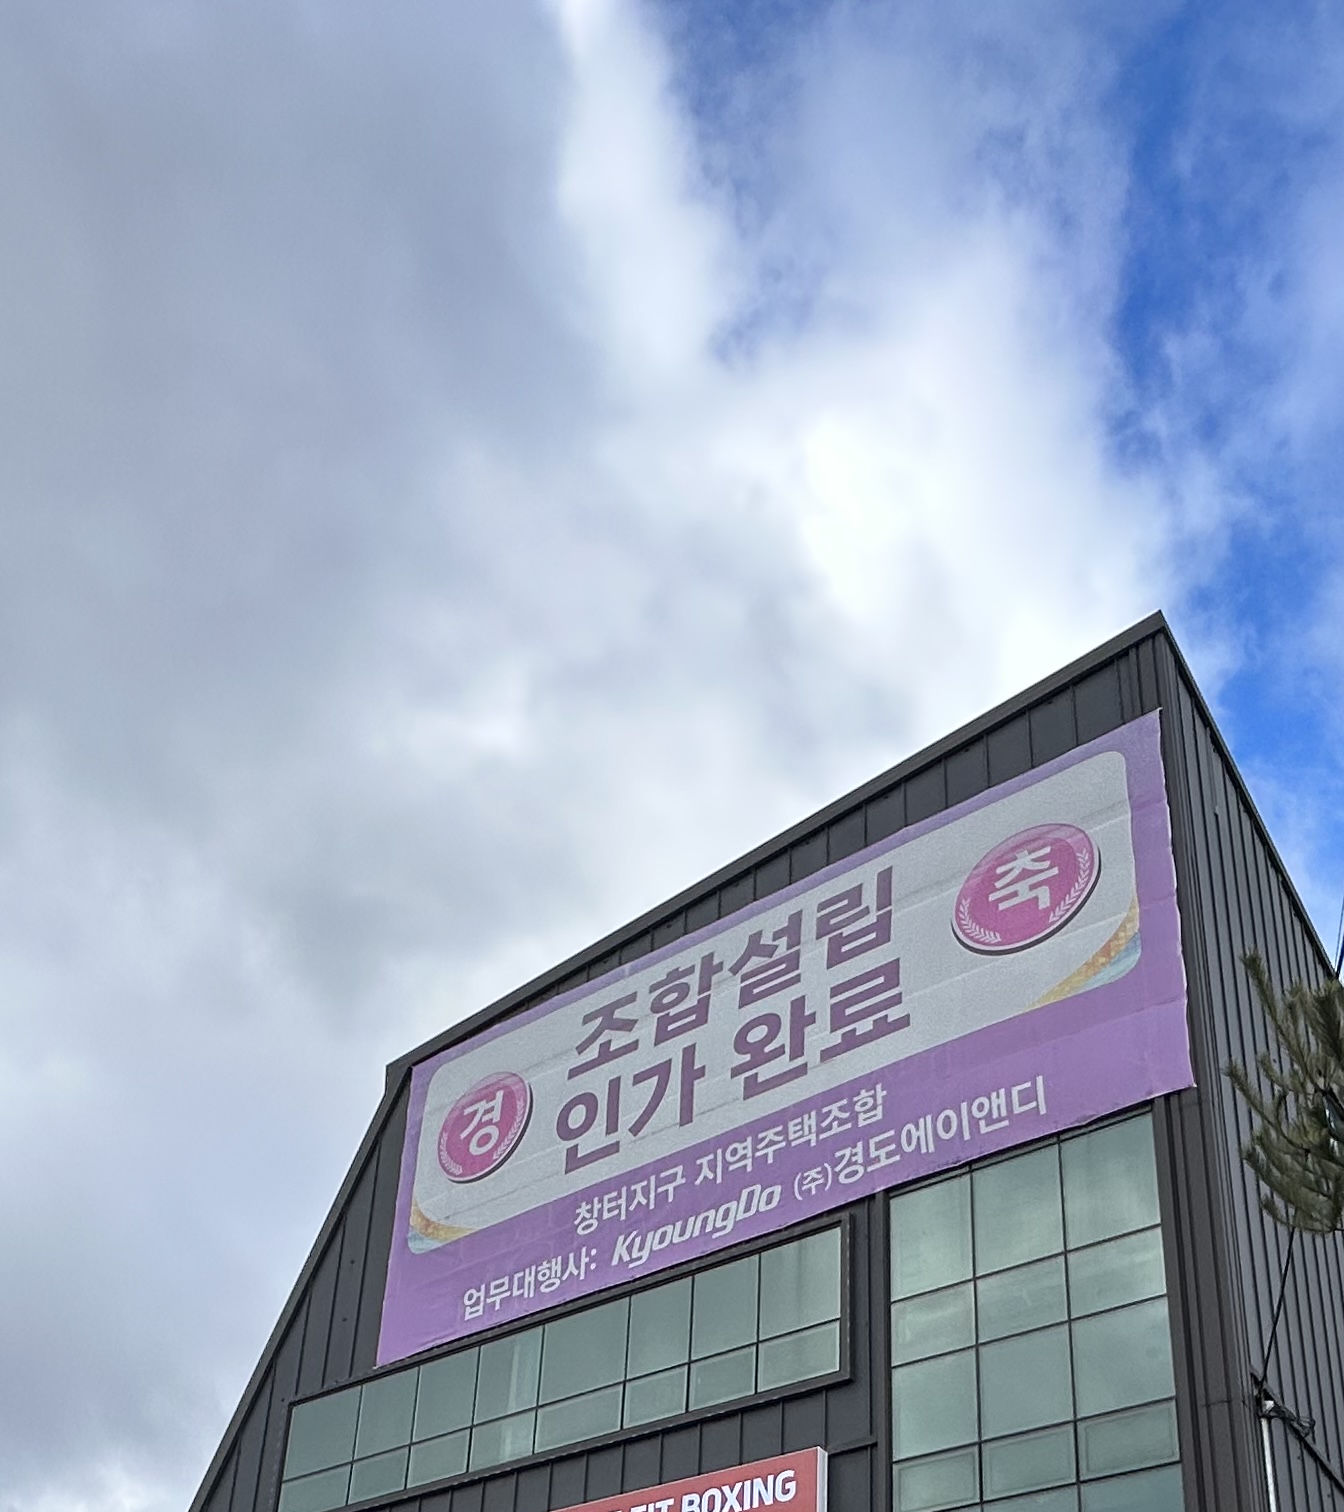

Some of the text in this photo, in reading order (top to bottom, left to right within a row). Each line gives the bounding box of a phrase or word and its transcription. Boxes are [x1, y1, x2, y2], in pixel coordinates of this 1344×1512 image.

[987, 843, 1061, 912] 축
[567, 866, 893, 1081] 조합설립
[460, 1089, 506, 1155] 경
[556, 957, 910, 1175] 인가 완료
[574, 1083, 888, 1236] 창터지구 지역주택조합
[463, 1246, 597, 1321] 업무대행사:
[611, 1184, 782, 1269] KyoungDo
